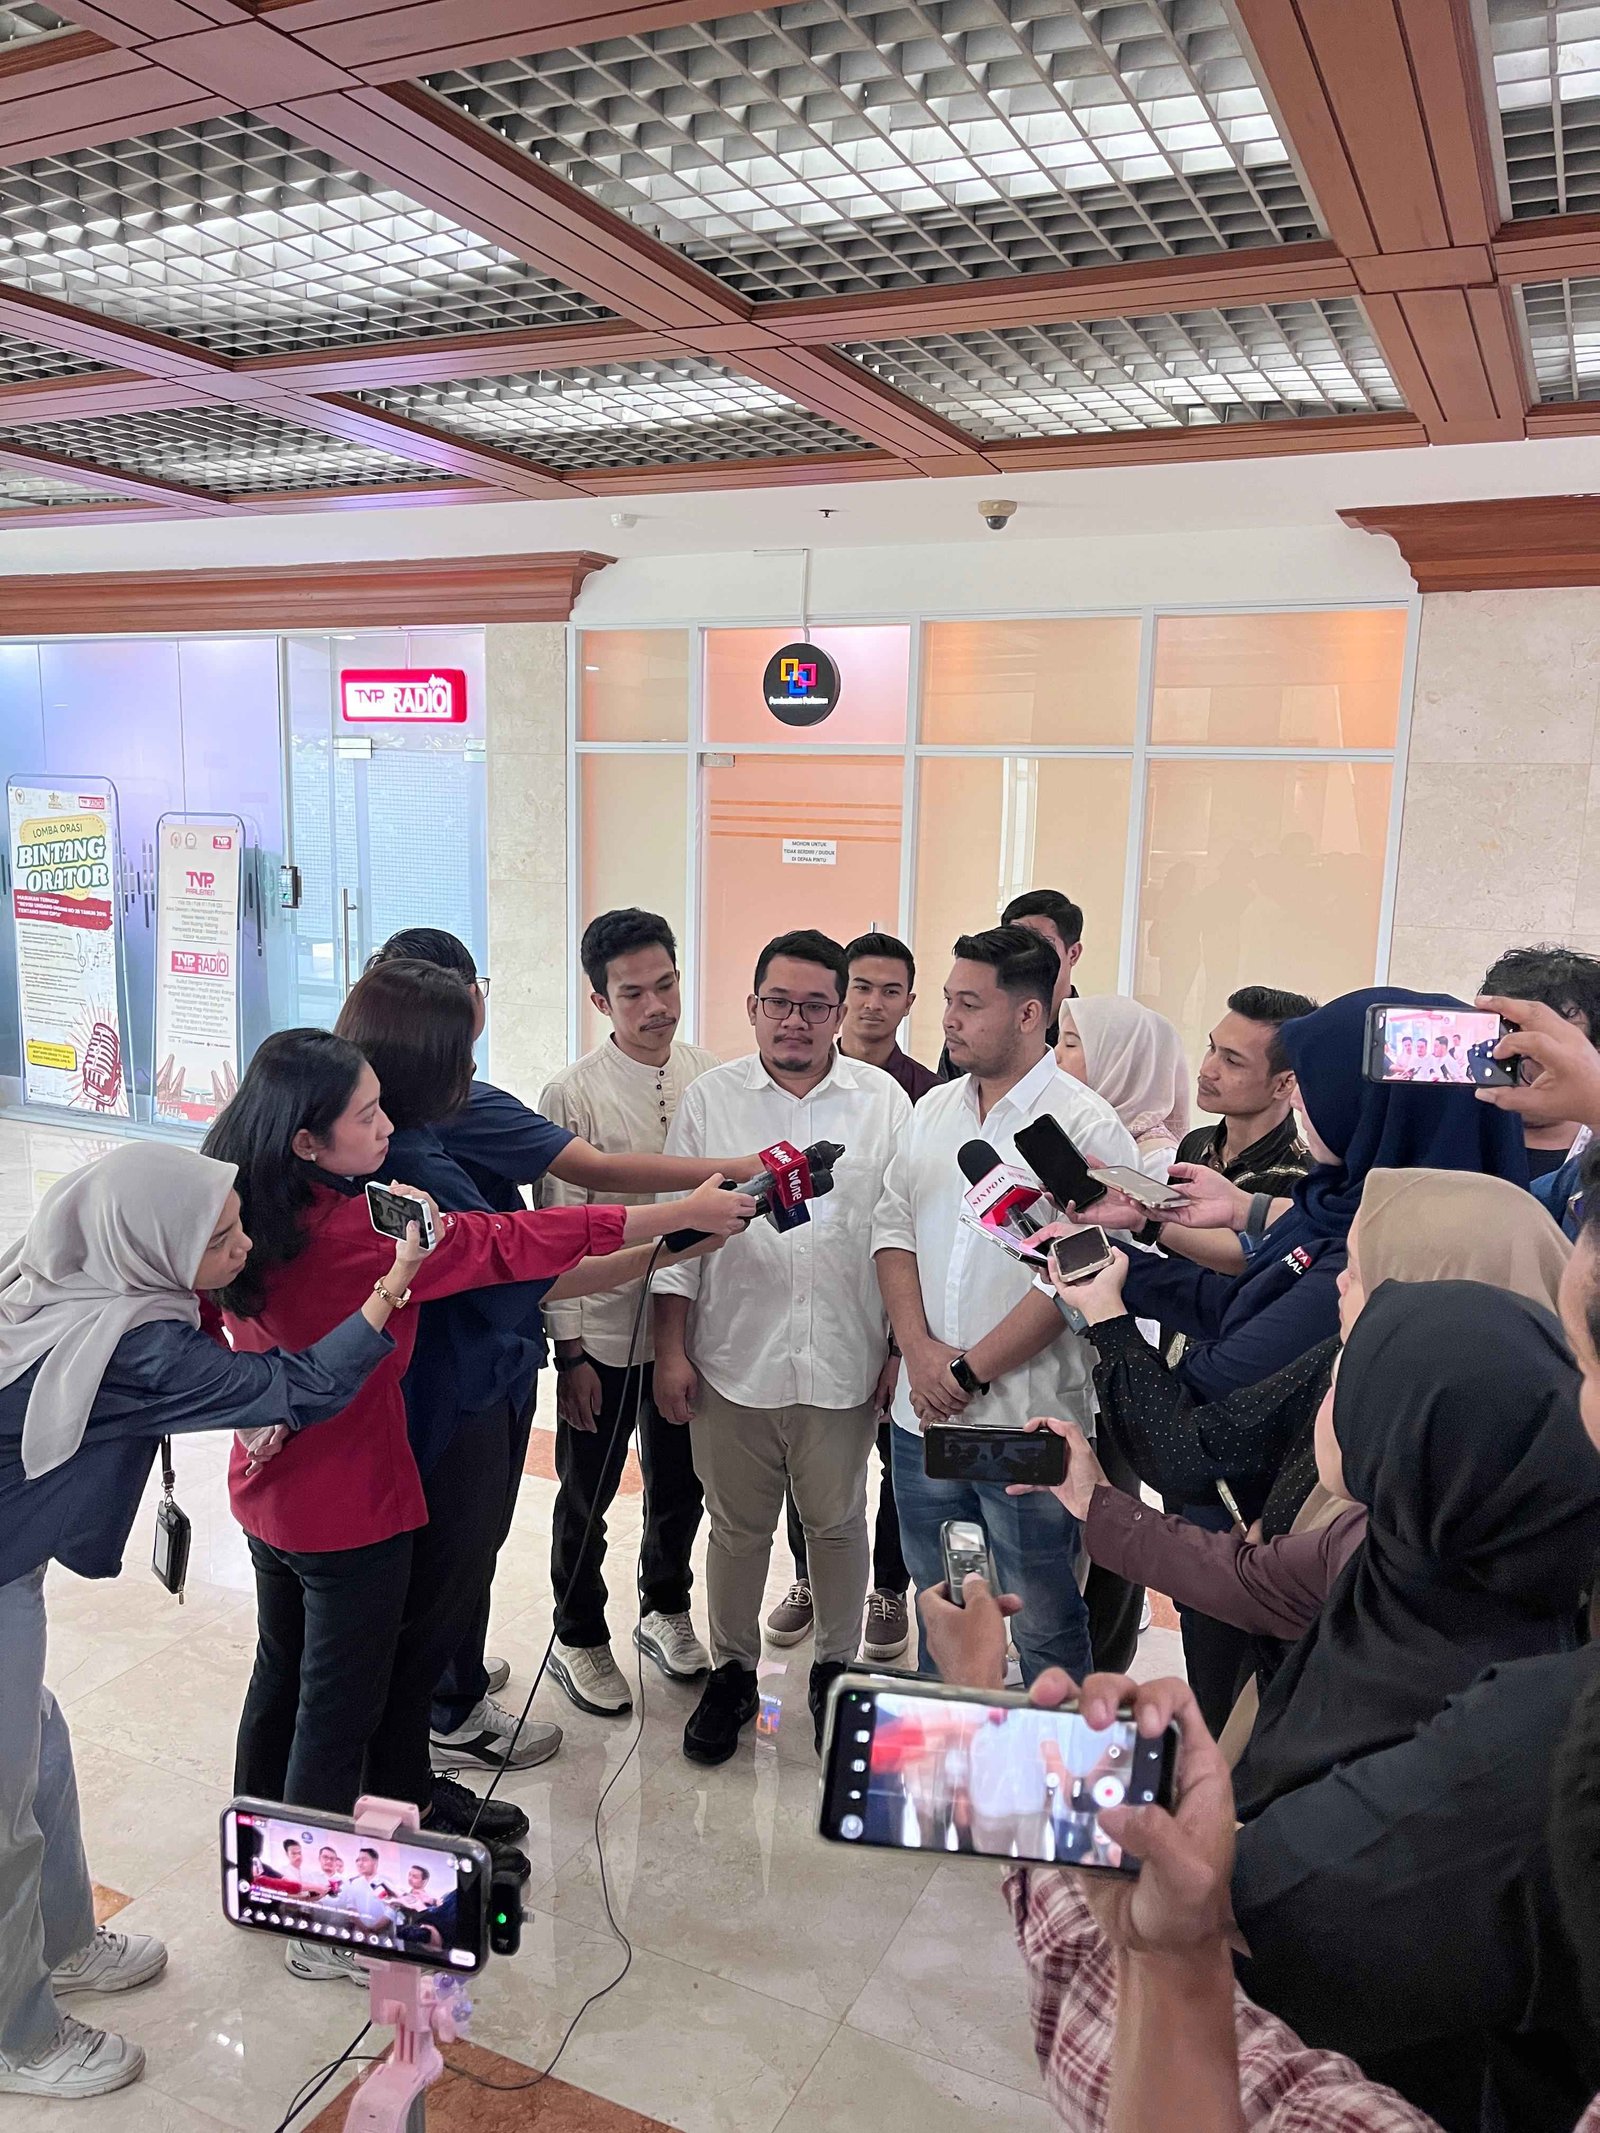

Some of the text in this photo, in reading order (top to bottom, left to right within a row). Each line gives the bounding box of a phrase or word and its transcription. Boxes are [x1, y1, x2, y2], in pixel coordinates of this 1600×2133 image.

[394, 687, 447, 713] RADIO
[32, 823, 82, 838] LOMBA ORASI
[17, 836, 106, 868] BINTANG
[27, 863, 109, 894] ORATOR
[198, 957, 227, 973] RADIO
[770, 1146, 792, 1165] tvOne
[788, 1168, 802, 1201] tvOne
